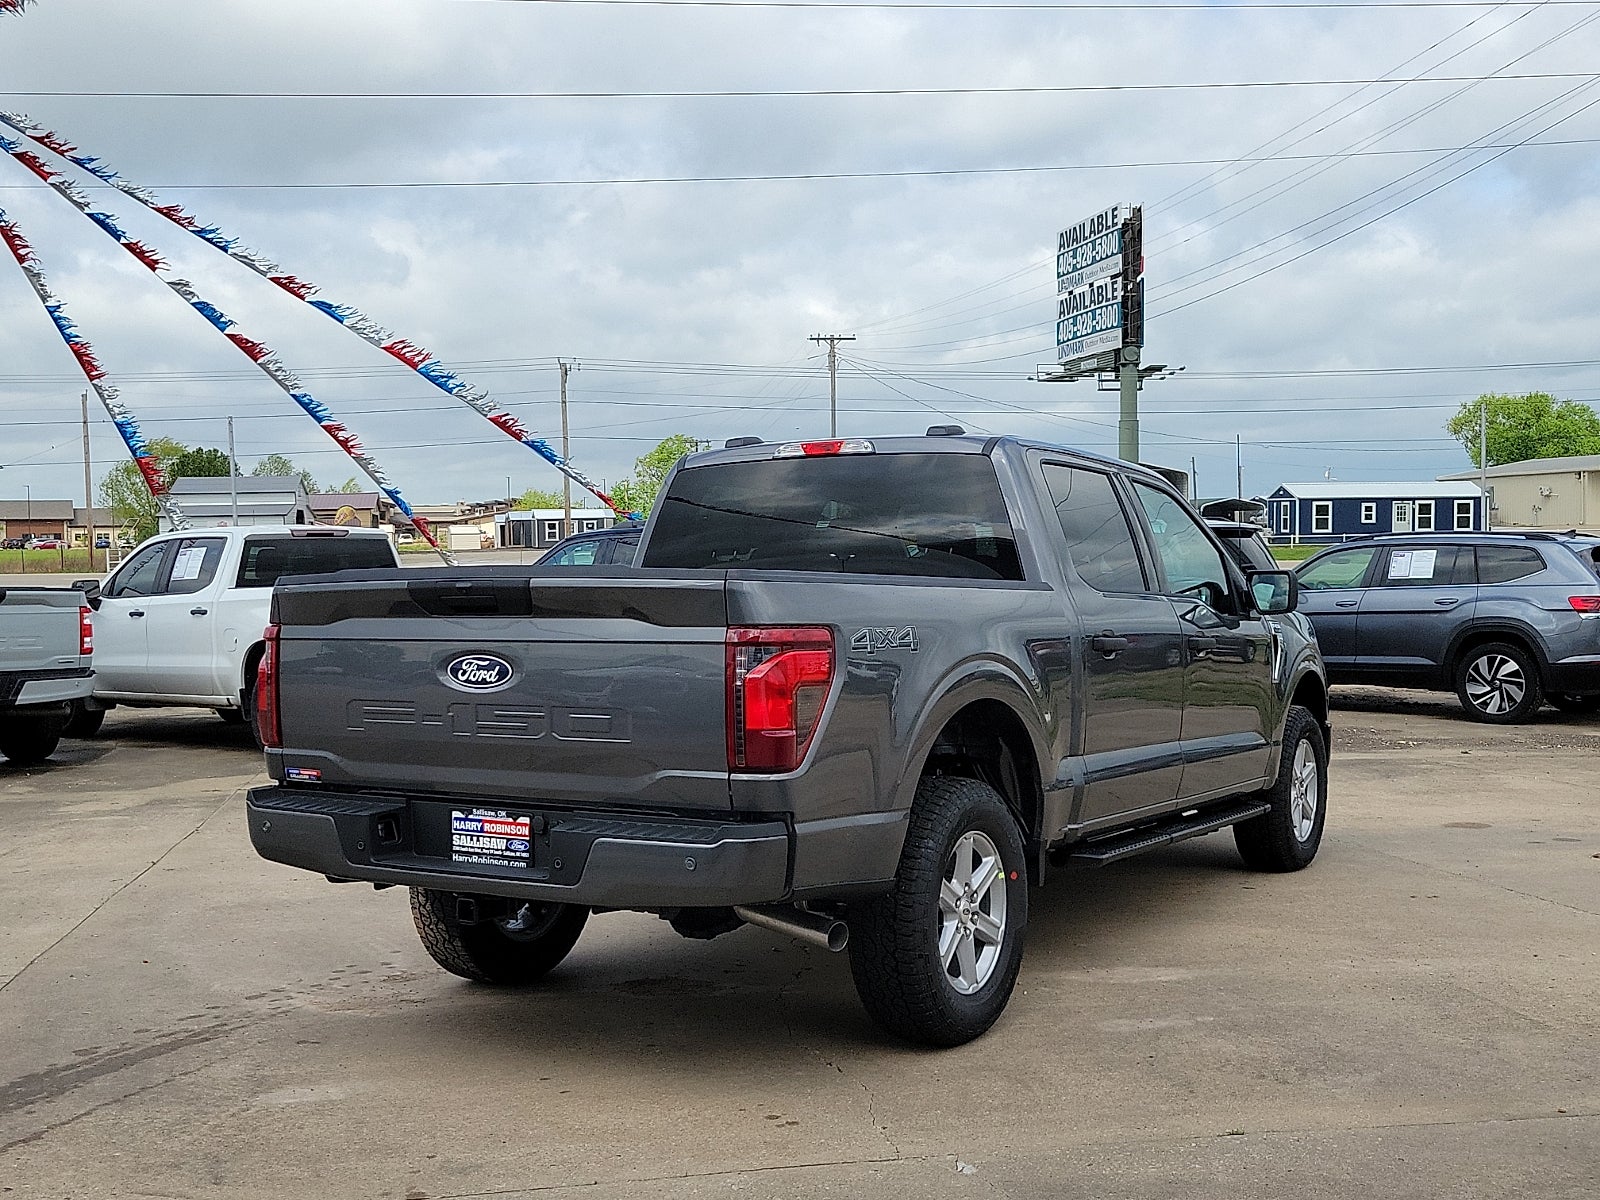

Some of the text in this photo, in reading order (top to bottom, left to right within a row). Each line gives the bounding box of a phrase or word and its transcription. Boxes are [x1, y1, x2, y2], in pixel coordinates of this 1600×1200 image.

[1058, 206, 1118, 252] AVAILABLE
[1058, 231, 1118, 276] 405-928-5800
[1058, 280, 1118, 320] AVAILABLE
[1058, 304, 1118, 343] 405-928-5800
[457, 658, 501, 683] Ford
[346, 699, 632, 743] F-150
[452, 834, 507, 850] SALLISAW
[453, 819, 529, 836] HARRY ROBINSON
[452, 853, 527, 868] HarryRobinson.com
